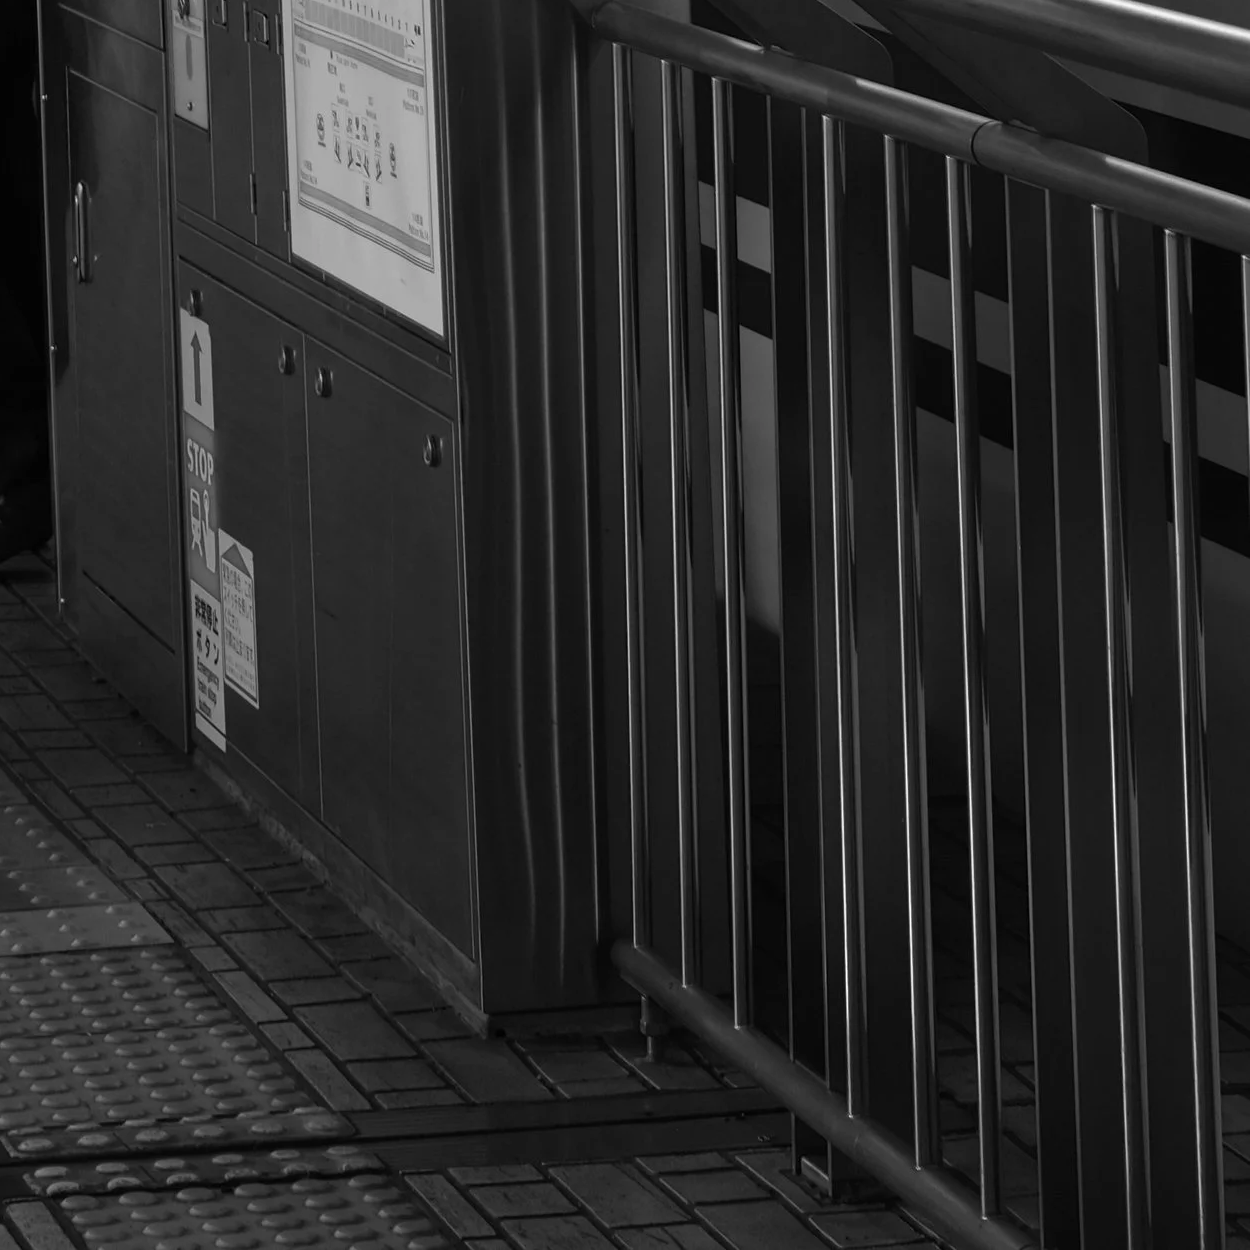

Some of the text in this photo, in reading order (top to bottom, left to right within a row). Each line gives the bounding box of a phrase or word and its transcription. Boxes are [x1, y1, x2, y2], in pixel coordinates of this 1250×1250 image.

[186, 438, 214, 485] STOP
[194, 594, 219, 636] 非常停止
[196, 629, 219, 665] ボタン
